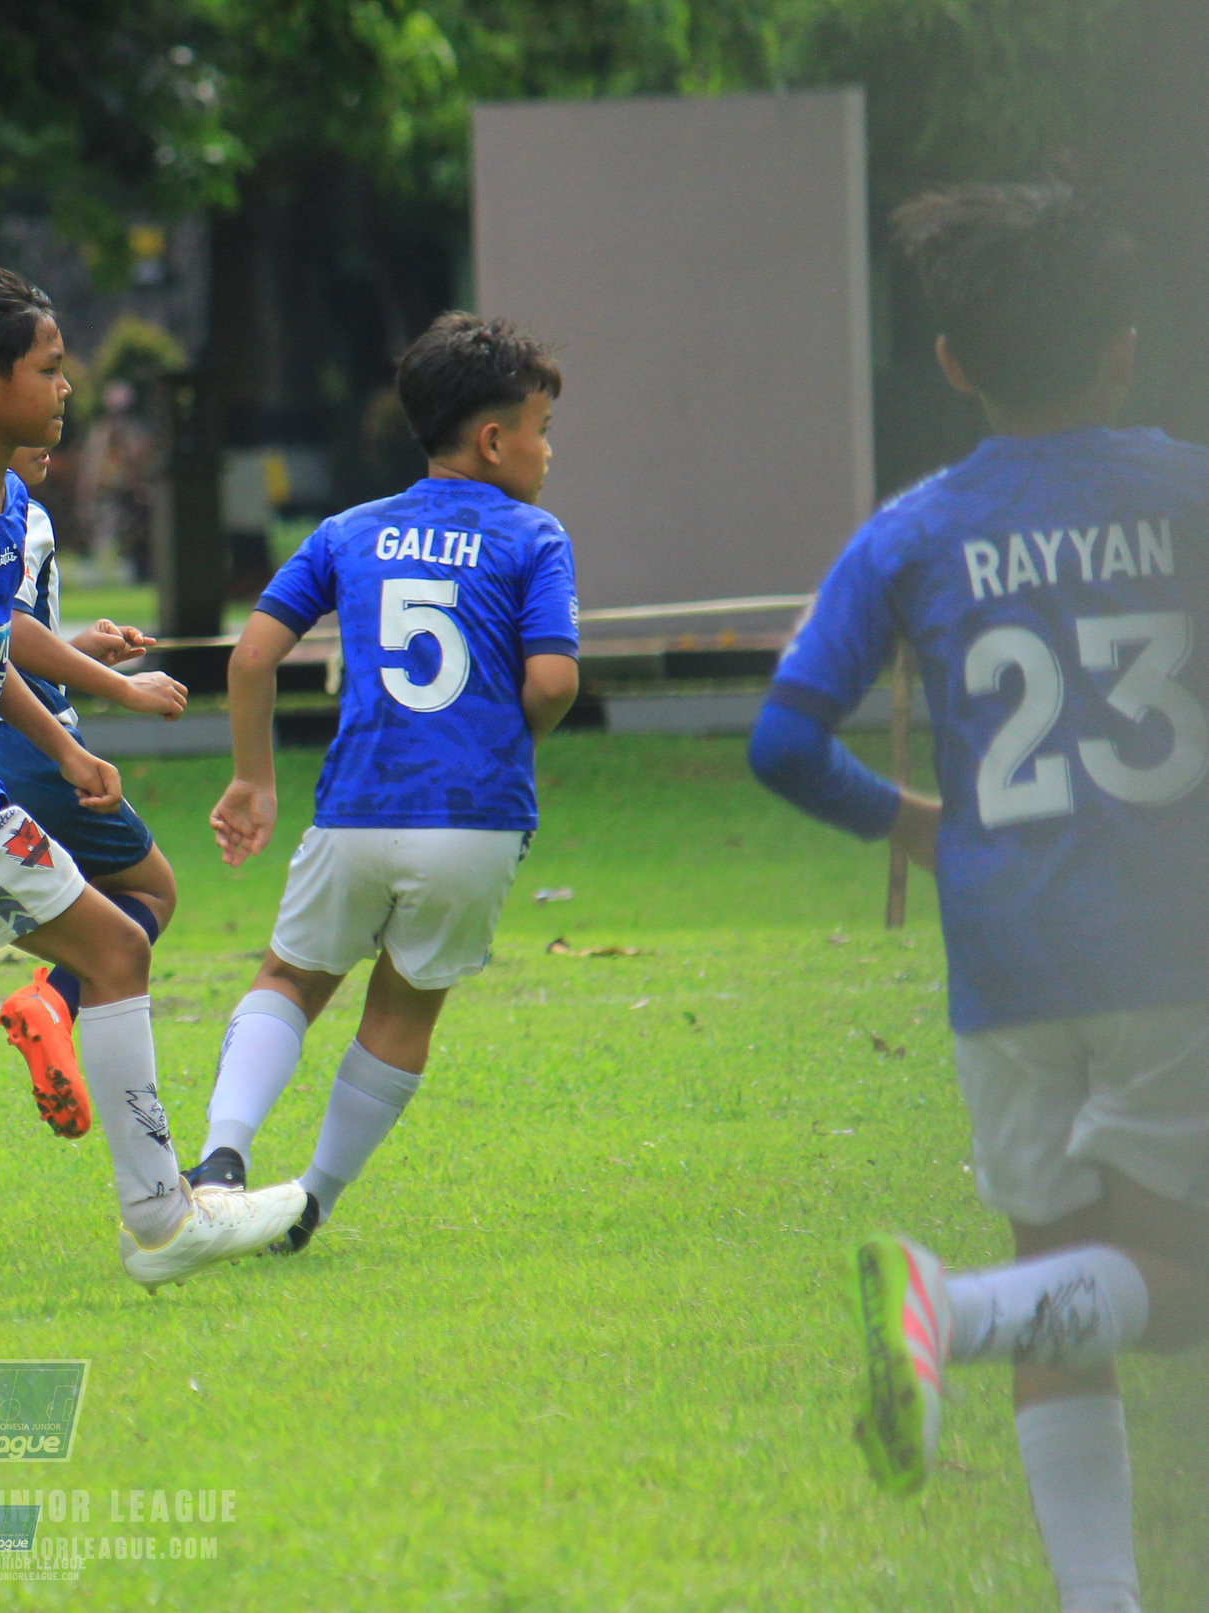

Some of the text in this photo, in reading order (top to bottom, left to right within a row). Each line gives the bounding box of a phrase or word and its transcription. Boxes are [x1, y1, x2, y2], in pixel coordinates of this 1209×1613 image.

[376, 526, 483, 569] GALIH
[963, 517, 1175, 600] RAYYAN
[379, 577, 472, 713] 5
[964, 610, 1209, 830] 23
